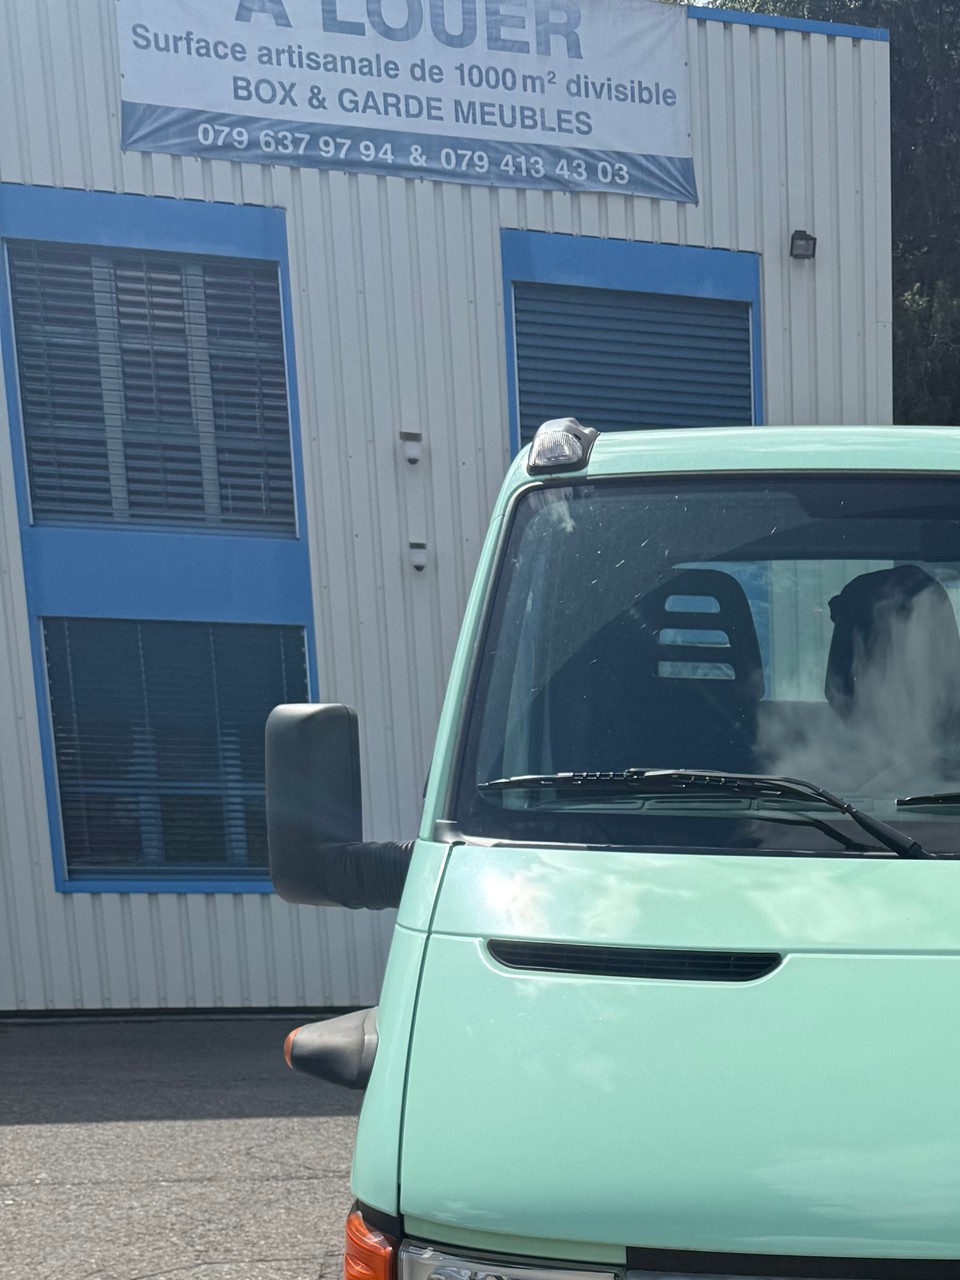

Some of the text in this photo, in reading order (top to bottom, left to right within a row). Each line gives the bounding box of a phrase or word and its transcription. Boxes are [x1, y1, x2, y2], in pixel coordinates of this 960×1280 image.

[321, 0, 585, 60] LOUER
[131, 23, 248, 62] Surface
[257, 44, 400, 80] artisanale
[409, 58, 445, 84] de
[454, 62, 518, 92] 1000
[565, 74, 678, 107] divisible
[232, 75, 594, 136] BOX & GARDE MEUBLES
[197, 123, 631, 185] 079 637 97 94 & 079 413 43 03
